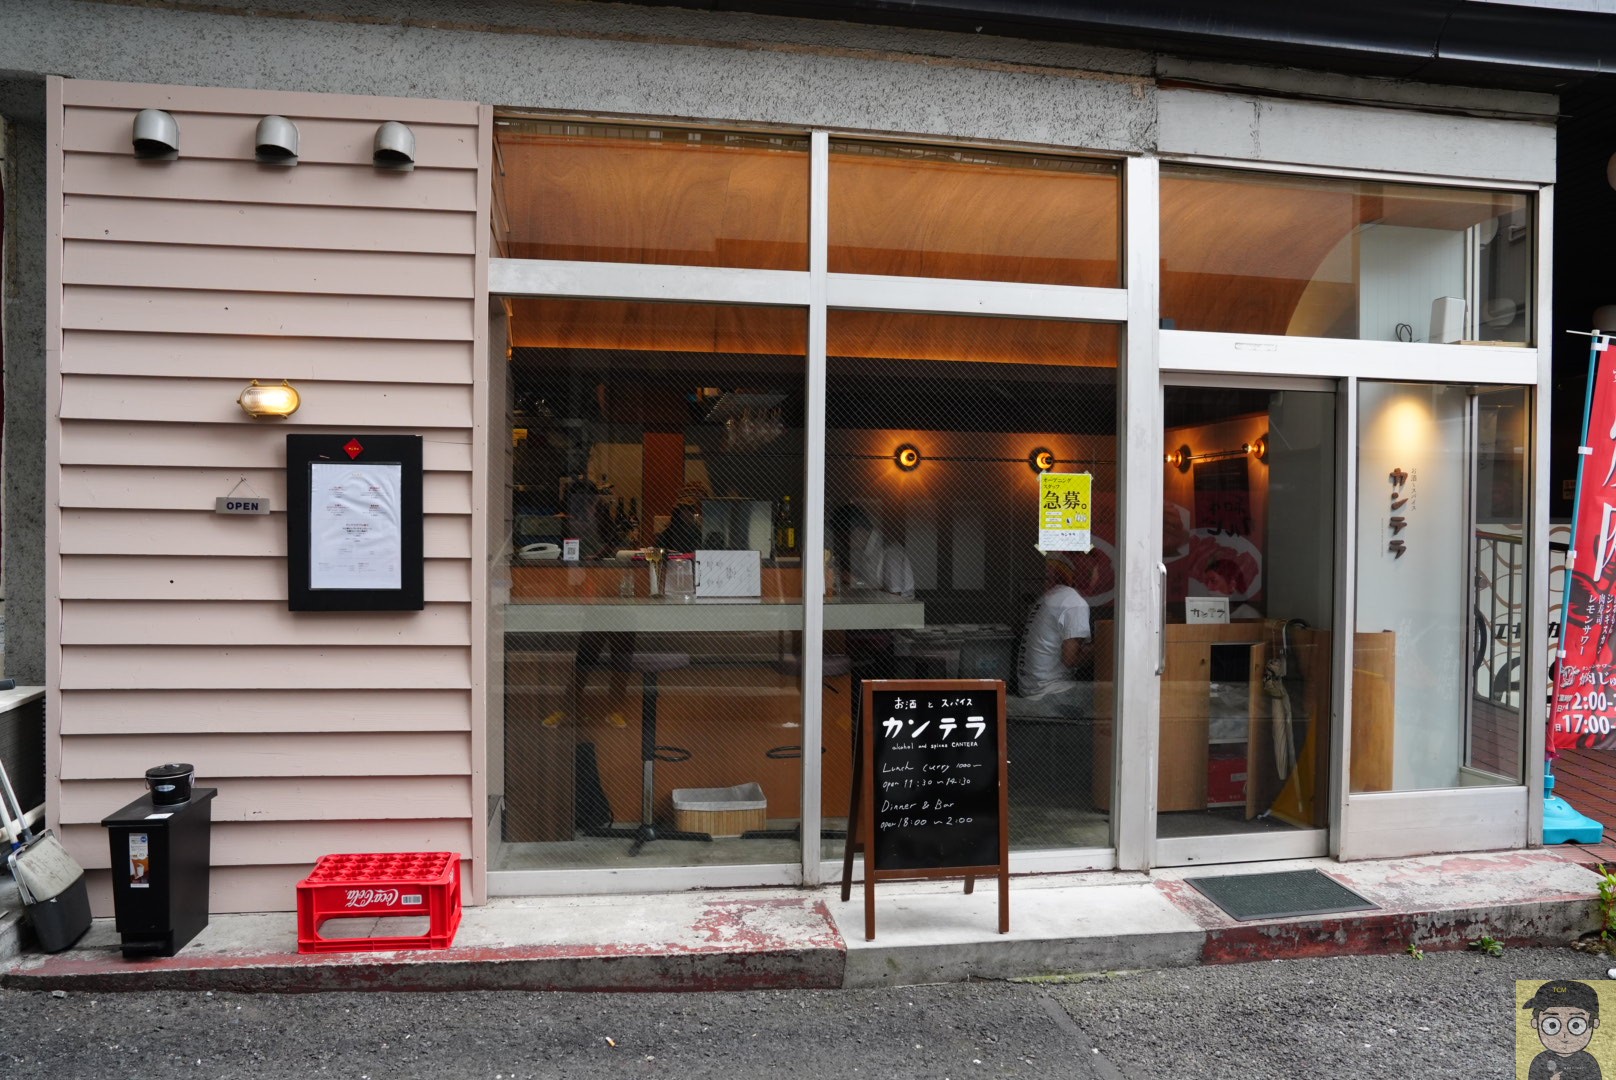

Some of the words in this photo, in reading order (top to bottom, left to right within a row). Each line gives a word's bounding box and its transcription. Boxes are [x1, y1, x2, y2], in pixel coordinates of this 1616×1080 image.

[226, 502, 259, 511] OPEN
[1043, 490, 1087, 510] 急募。
[1389, 468, 1409, 560] カンテラ
[1580, 594, 1597, 655] レモンサワー
[894, 697, 917, 710] お酒
[941, 698, 973, 707] スパイス
[882, 716, 986, 740] カンテラ
[882, 761, 914, 773] Lunch
[882, 780, 899, 792] open
[881, 800, 917, 813] Dinner
[922, 801, 930, 810] &
[935, 799, 955, 810] Bar
[880, 820, 896, 831] open
[345, 888, 399, 907] Coca-Cola
